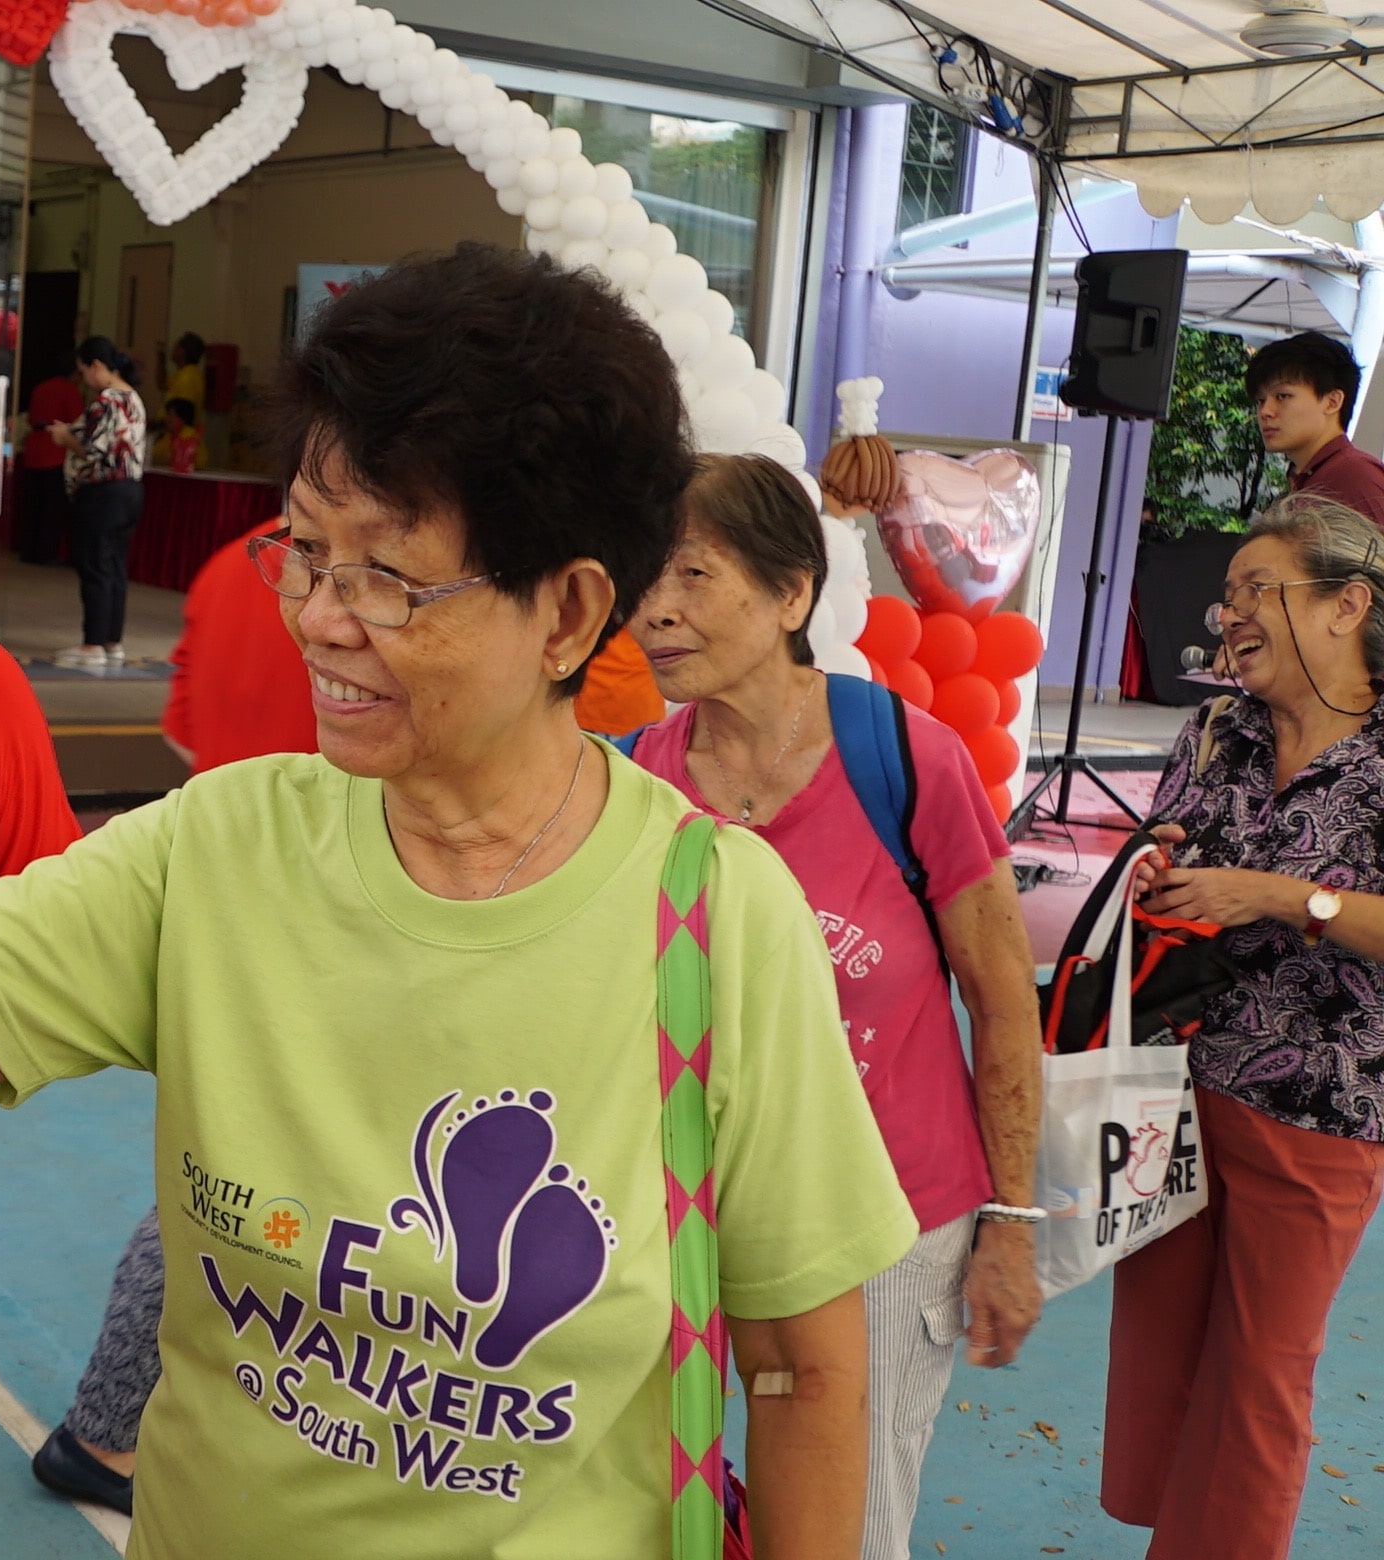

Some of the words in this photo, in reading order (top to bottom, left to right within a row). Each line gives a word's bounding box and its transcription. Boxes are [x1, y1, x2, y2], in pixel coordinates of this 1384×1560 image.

[182, 1151, 255, 1209] SOUTH
[191, 1184, 246, 1237] WEST
[1096, 1207, 1122, 1247] OF
[1126, 1195, 1157, 1239] THE
[210, 1228, 264, 1257] DEVELOPMENT
[265, 1251, 304, 1269] COUNCIL
[318, 1217, 472, 1358] FUN
[199, 1253, 576, 1442] WALKERS
[235, 1364, 264, 1401] @
[272, 1366, 377, 1466] South
[393, 1422, 525, 1502] West
